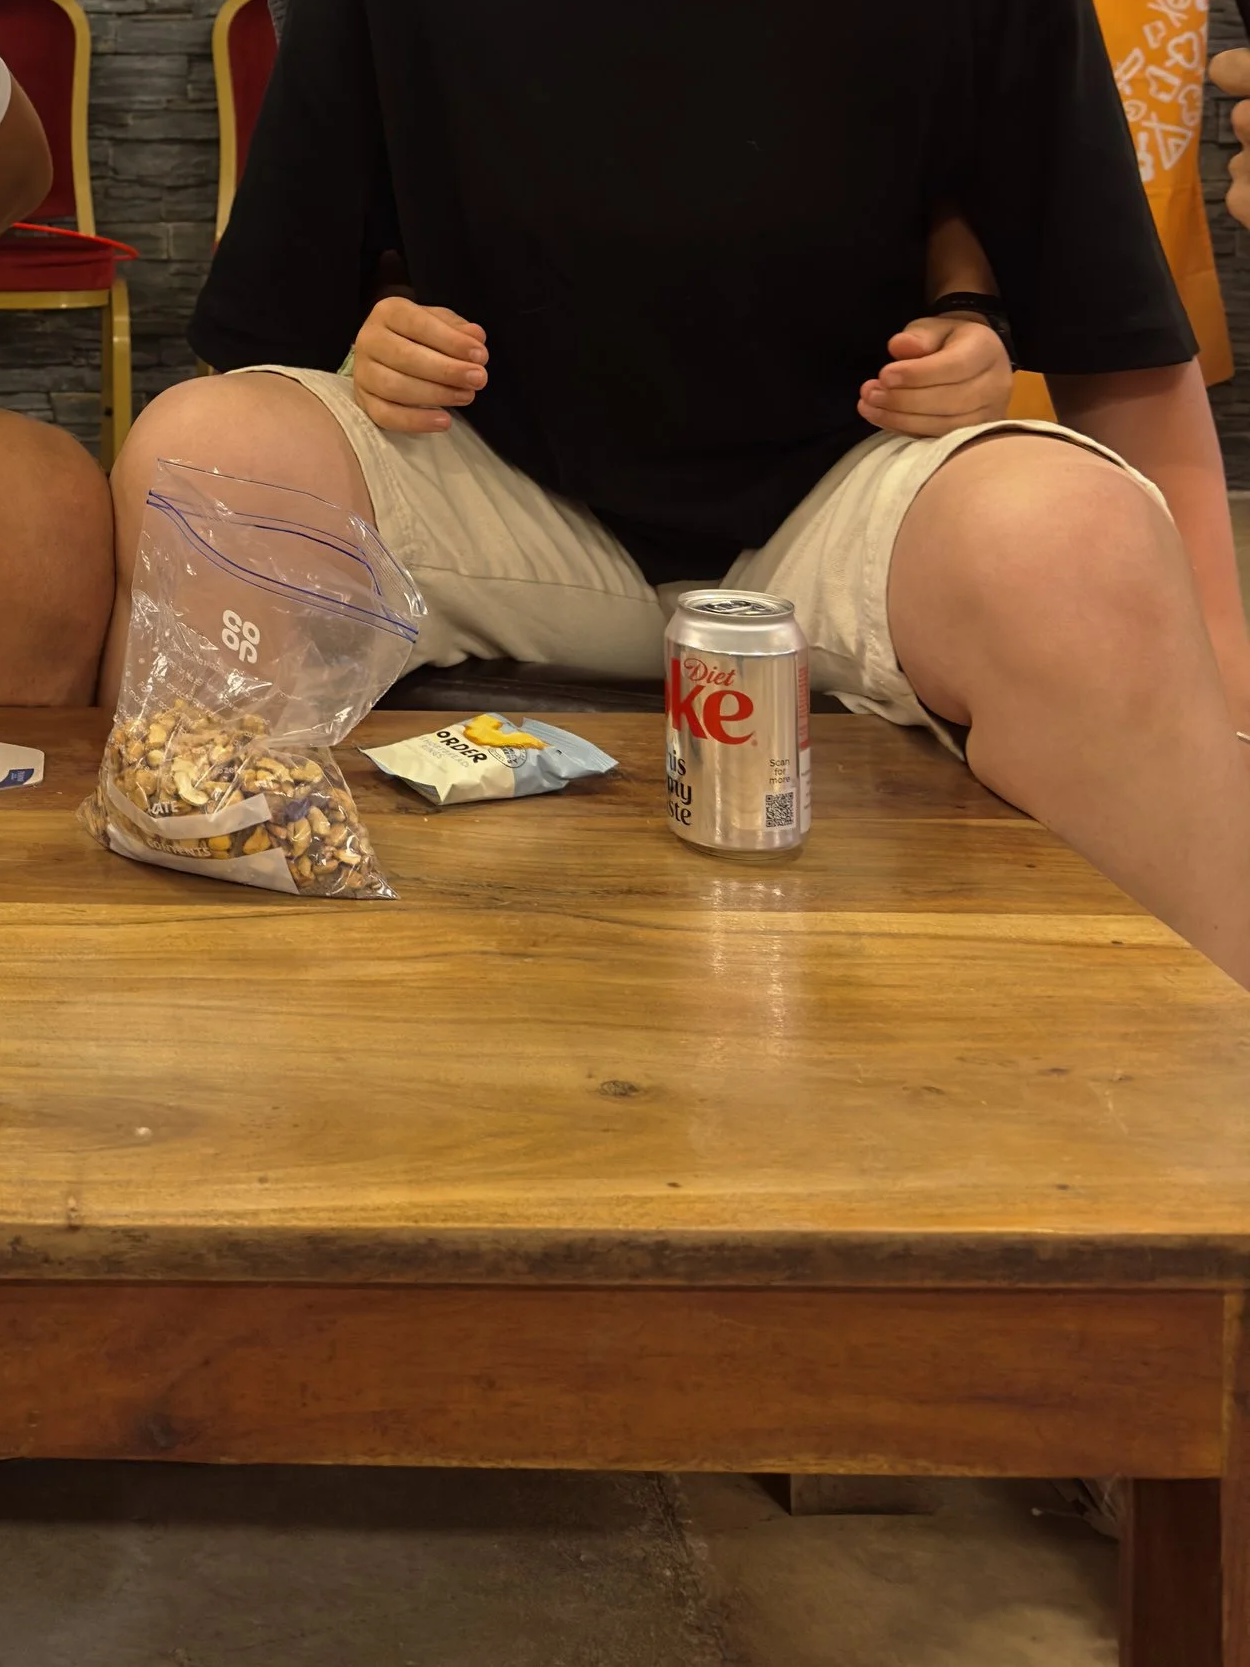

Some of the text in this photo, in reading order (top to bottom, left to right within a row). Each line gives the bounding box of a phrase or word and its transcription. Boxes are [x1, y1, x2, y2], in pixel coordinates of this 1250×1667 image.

[683, 657, 736, 687] Diet
[769, 758, 790, 767] Scan
[774, 767, 786, 776] for
[769, 776, 791, 784] more
[667, 800, 692, 826] ste
